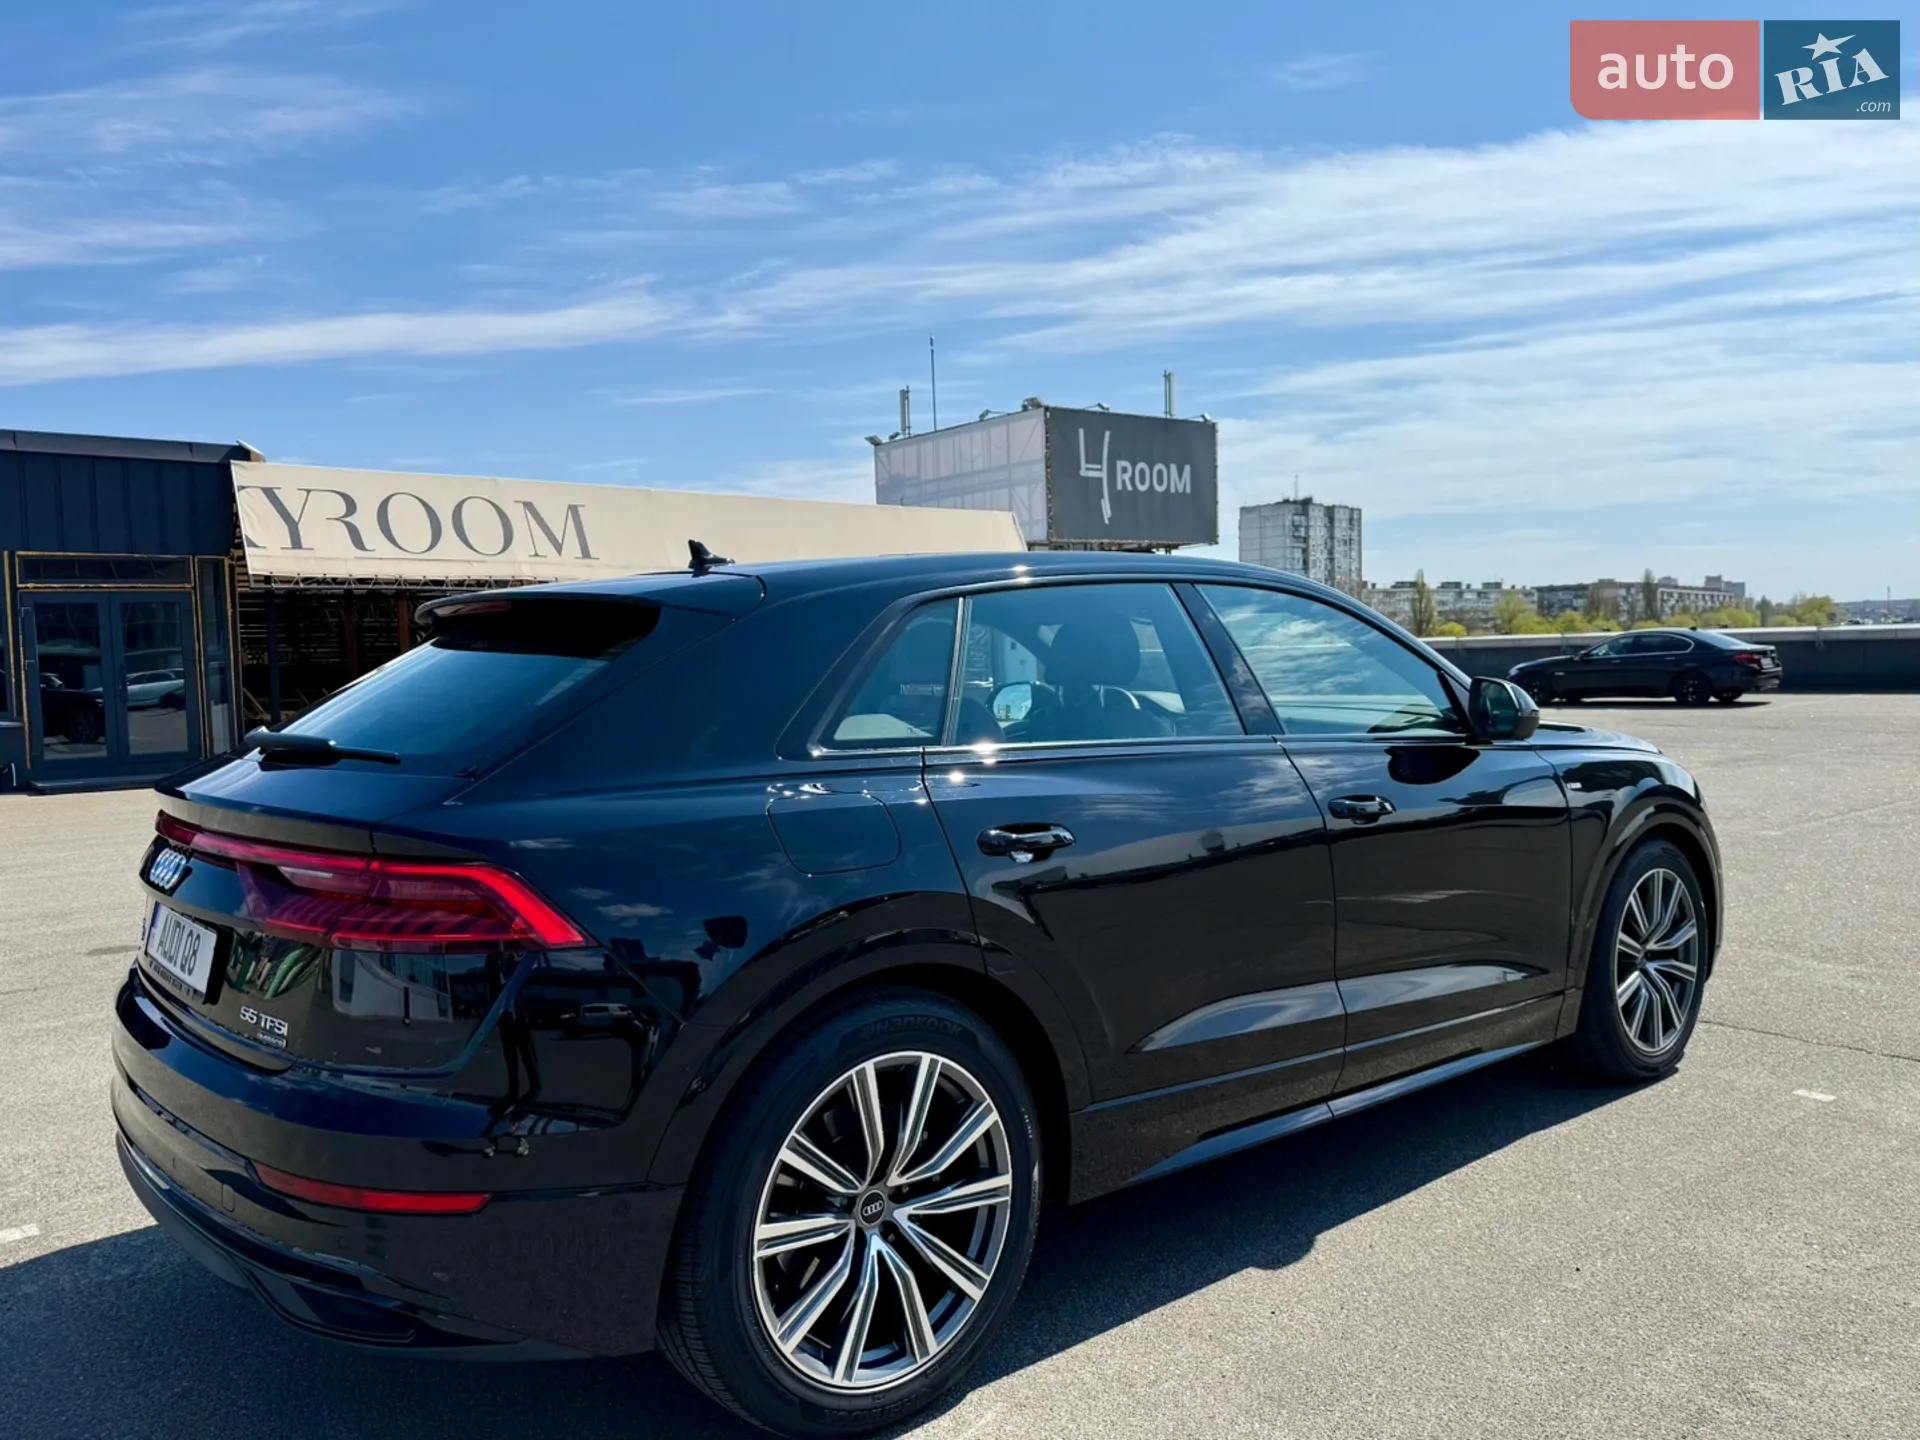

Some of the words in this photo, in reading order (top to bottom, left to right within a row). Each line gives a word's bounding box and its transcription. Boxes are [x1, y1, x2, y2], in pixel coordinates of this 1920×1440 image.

[1078, 427, 1112, 525] 4
[1115, 460, 1192, 494] ROOM
[239, 1005, 257, 1024] 55
[259, 1013, 288, 1036] TFSI
